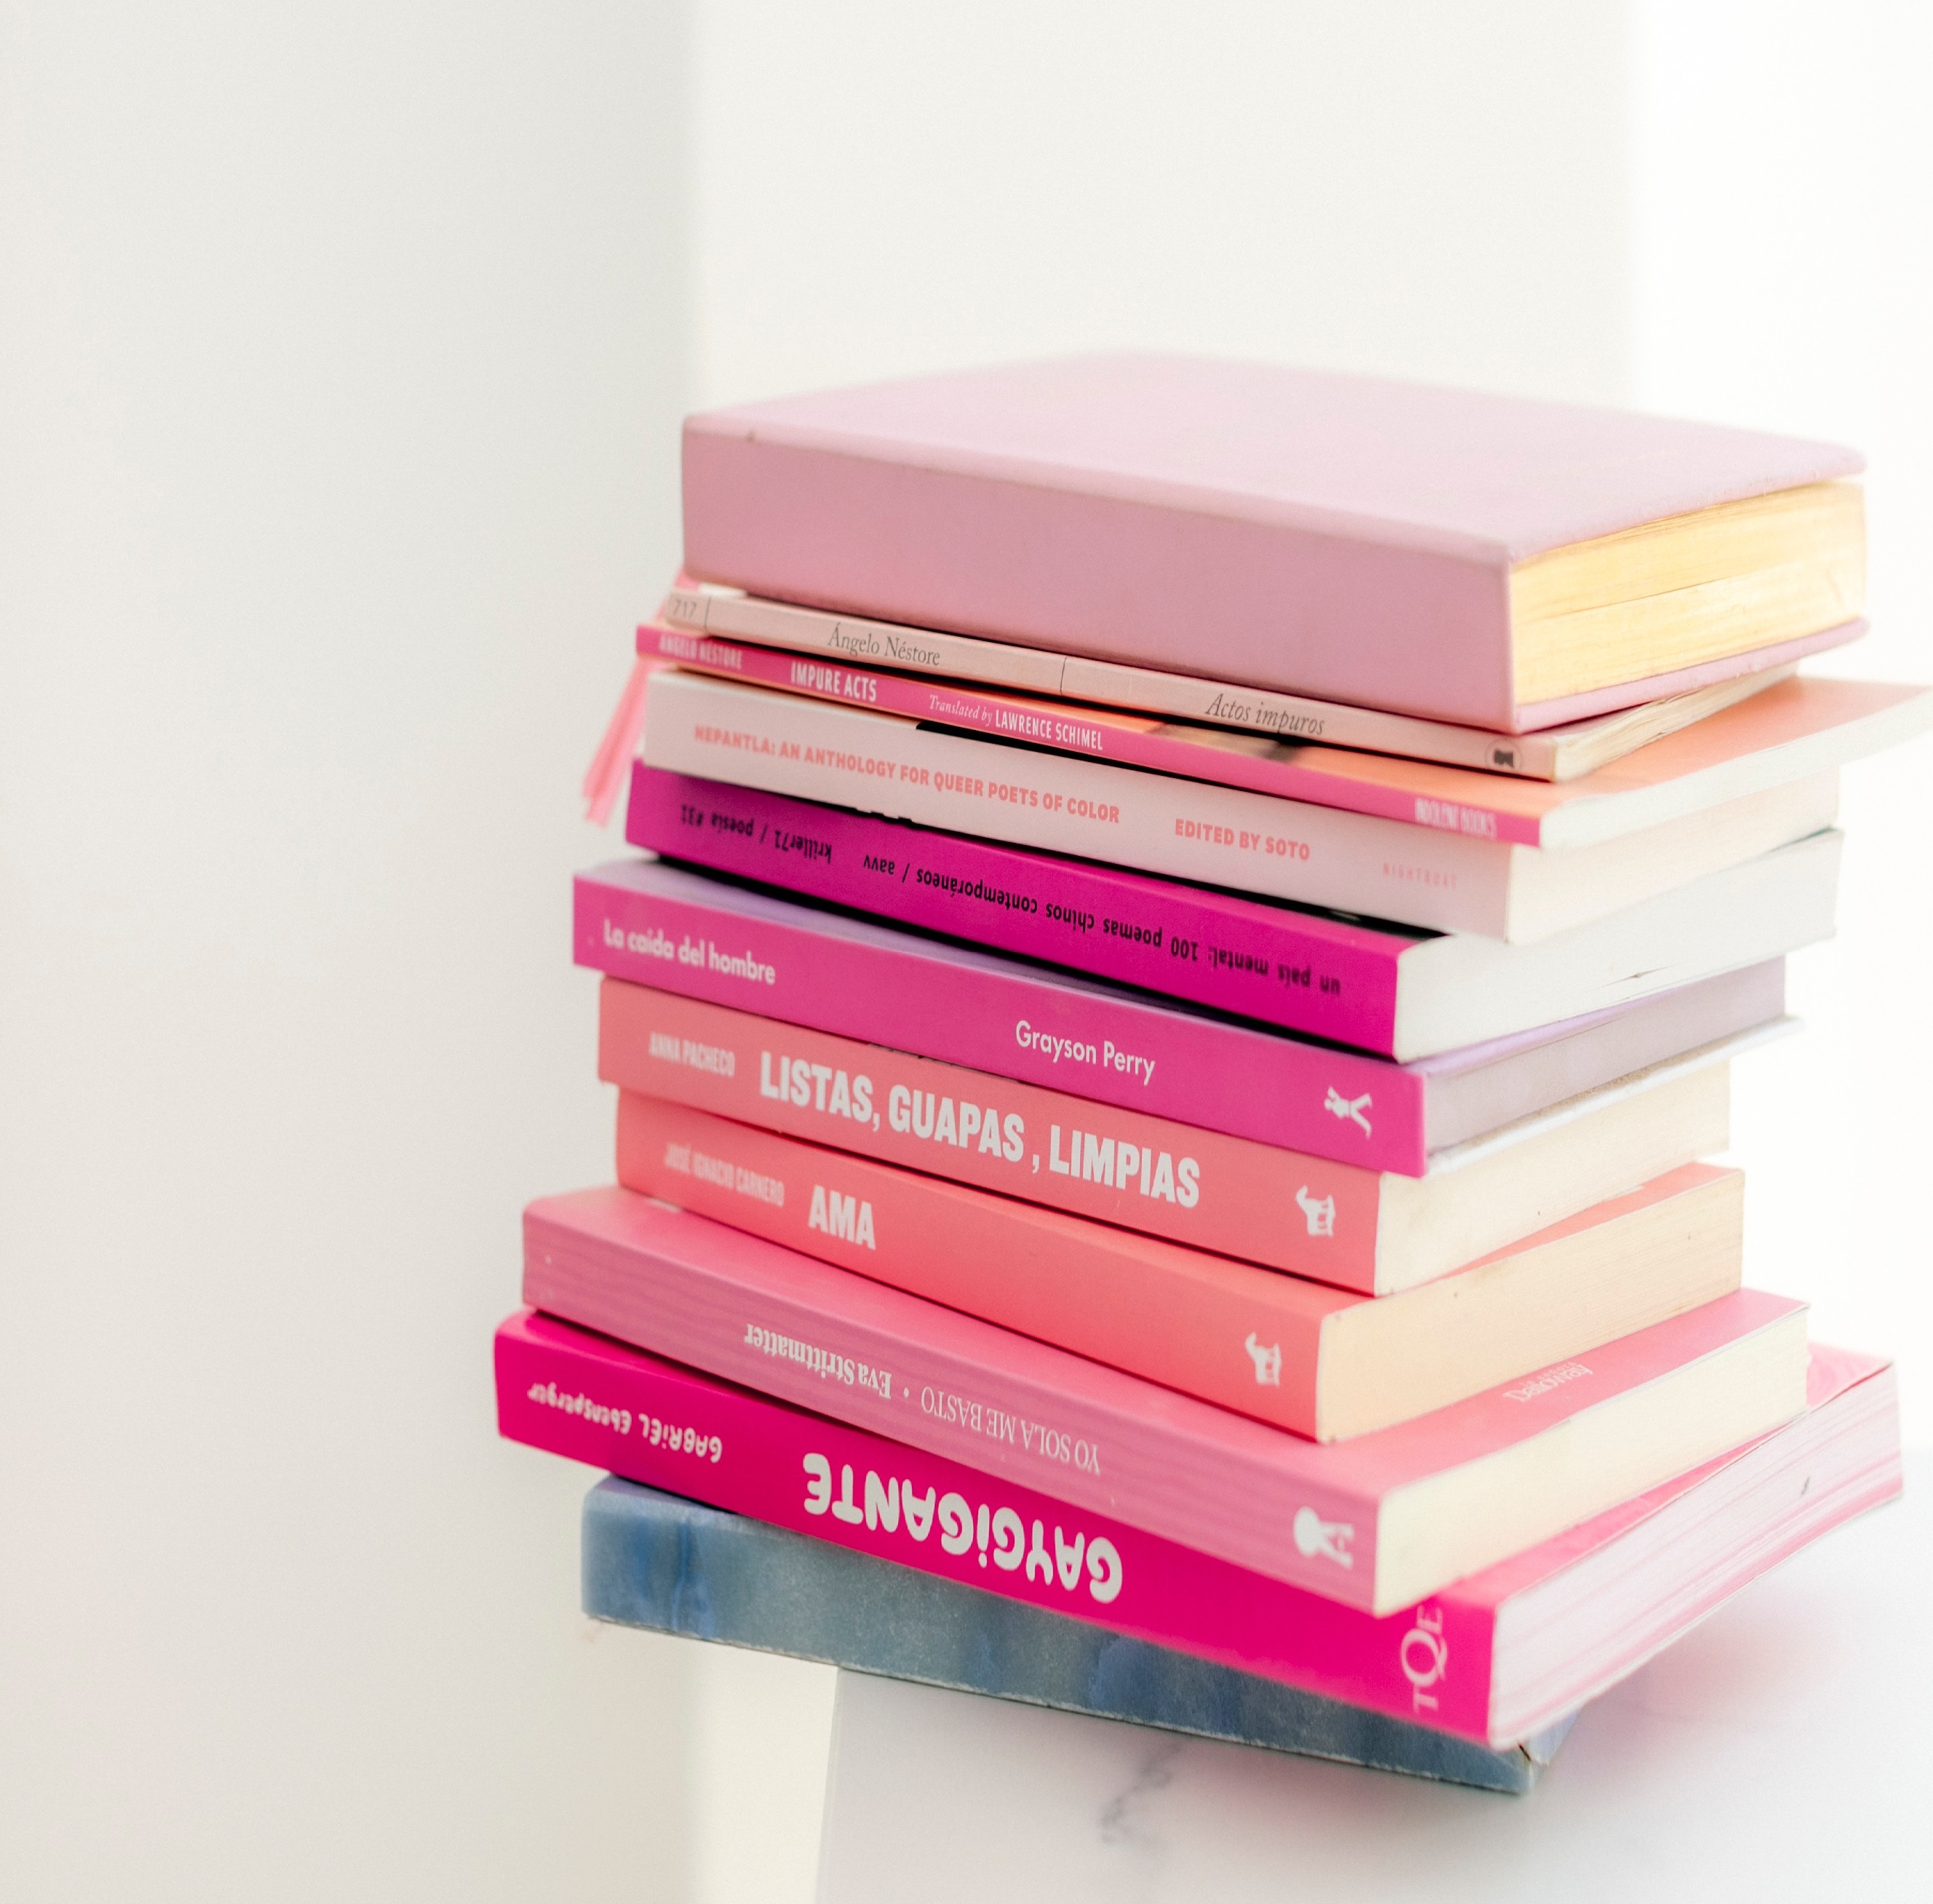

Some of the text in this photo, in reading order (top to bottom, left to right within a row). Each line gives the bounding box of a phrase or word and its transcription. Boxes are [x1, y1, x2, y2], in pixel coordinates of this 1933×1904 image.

[672, 599, 696, 617] 717
[827, 622, 940, 666] Ángelo Néstore
[790, 661, 841, 694] IMPURE
[844, 673, 878, 702] ACTS
[929, 694, 980, 719] Translated
[981, 707, 993, 727] by
[996, 709, 1052, 739] LAWRENCE
[1055, 722, 1103, 751] SCHIMEL
[1204, 693, 1325, 735] Actos impuros
[695, 725, 776, 755] NEPANTLA:
[779, 741, 801, 760] AN
[804, 747, 896, 779] ANTHOLOGY
[900, 765, 929, 786] FOR
[934, 771, 984, 796] QUEER
[988, 782, 1038, 807] POETS
[1043, 793, 1063, 812] OF
[1067, 797, 1119, 823] COLOR
[1175, 818, 1235, 846] EDITED
[1239, 831, 1261, 852] BY
[1265, 837, 1310, 861] SOTO
[774, 830, 832, 865] kriller71
[862, 854, 895, 876] aavv
[916, 868, 1039, 913] contemporáneos
[1045, 903, 1095, 933] chinos
[1103, 917, 1163, 948] poemas
[1170, 935, 1199, 962] 100
[1207, 946, 1269, 976] mental:
[603, 917, 624, 948] La
[678, 935, 705, 967] del
[707, 940, 777, 985] hombre
[1015, 1020, 1097, 1063] Grayson
[1103, 1040, 1156, 1087] Perry
[1319, 976, 1341, 996] un
[760, 1051, 881, 1133] LISTAS,
[888, 1084, 1025, 1162] GUAPAS
[1049, 1124, 1201, 1208] LIMPIAS
[808, 1184, 876, 1250] AMA
[744, 1323, 1101, 1476] YO SOLA ME BASTO Eva Strittmatter
